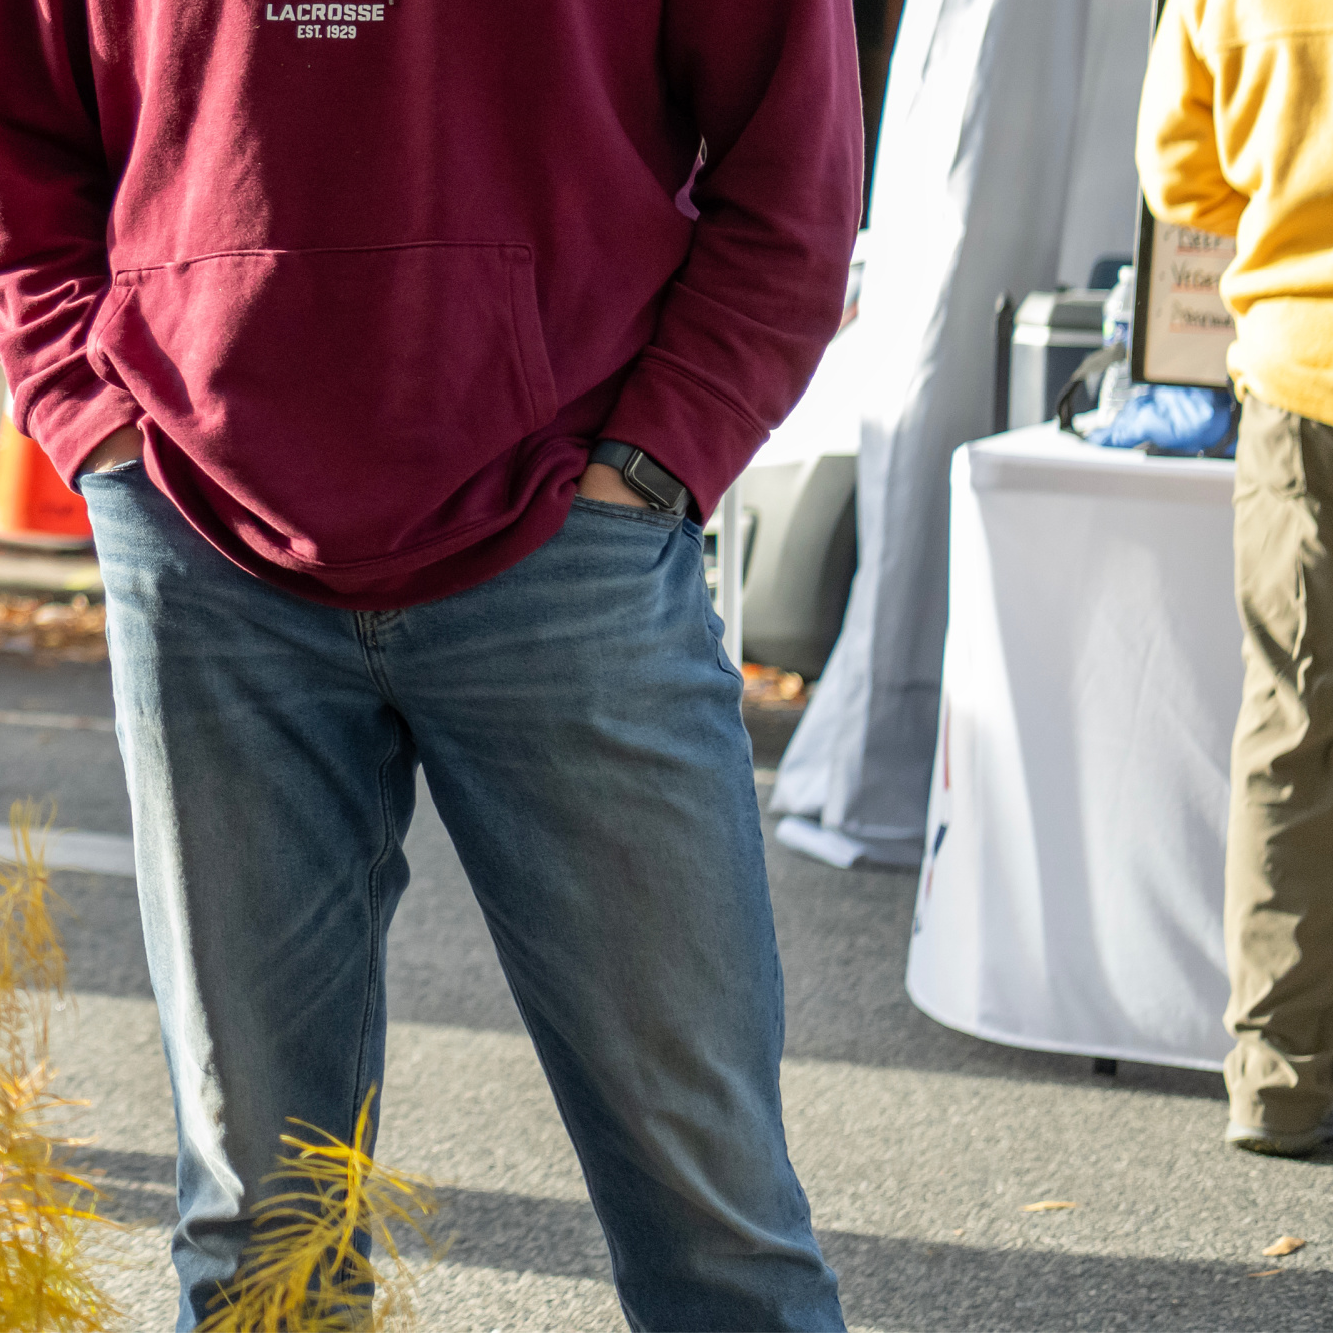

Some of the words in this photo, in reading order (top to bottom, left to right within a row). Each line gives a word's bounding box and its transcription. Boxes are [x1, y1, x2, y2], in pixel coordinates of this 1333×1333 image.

[266, 3, 385, 22] LACROSSE
[297, 24, 323, 39] EST.
[326, 24, 357, 40] 1929
